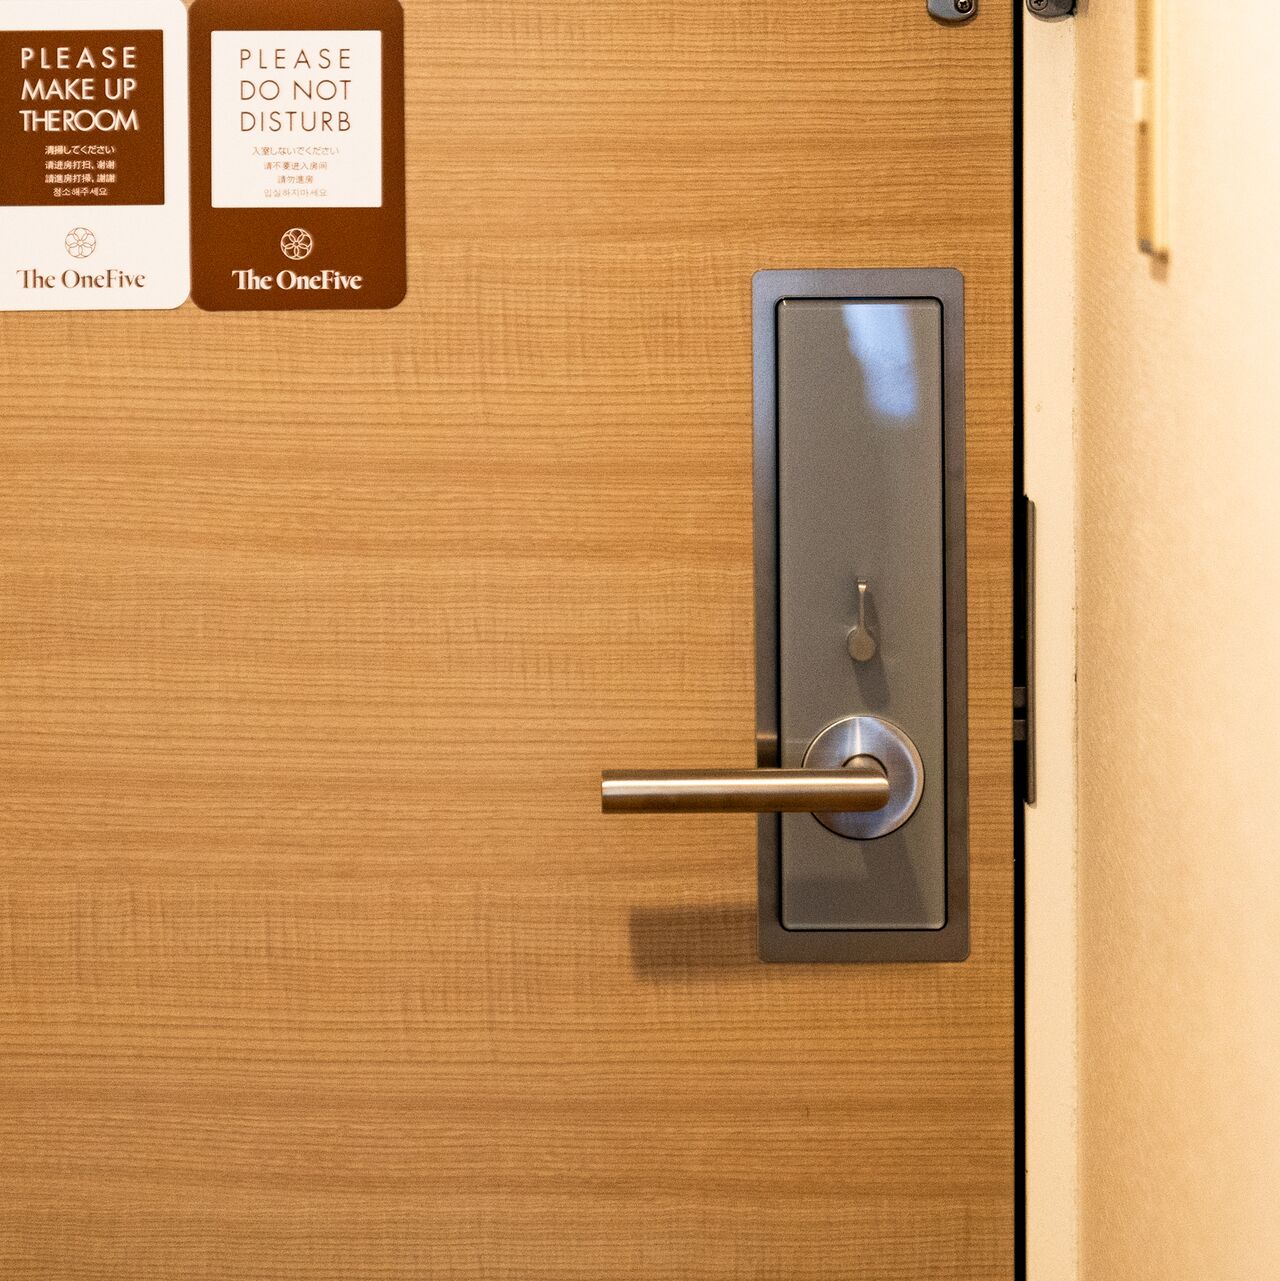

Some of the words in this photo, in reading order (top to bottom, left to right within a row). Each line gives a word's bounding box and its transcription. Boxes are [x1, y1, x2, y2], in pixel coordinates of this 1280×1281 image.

[21, 46, 137, 69] PLEASE
[240, 48, 351, 69] PLEASE
[21, 78, 95, 100] MAKE
[104, 78, 137, 100] UP
[240, 79, 280, 101] DO
[293, 79, 351, 101] NOT
[240, 111, 351, 132] DISTURB
[45, 145, 115, 155] 清掃してください
[252, 146, 340, 156] 入室しないでください
[53, 187, 108, 197] 청소해주세요
[16, 268, 56, 289] The
[61, 268, 146, 289] OneFive
[232, 269, 272, 290] The
[275, 269, 362, 290] OneFive
